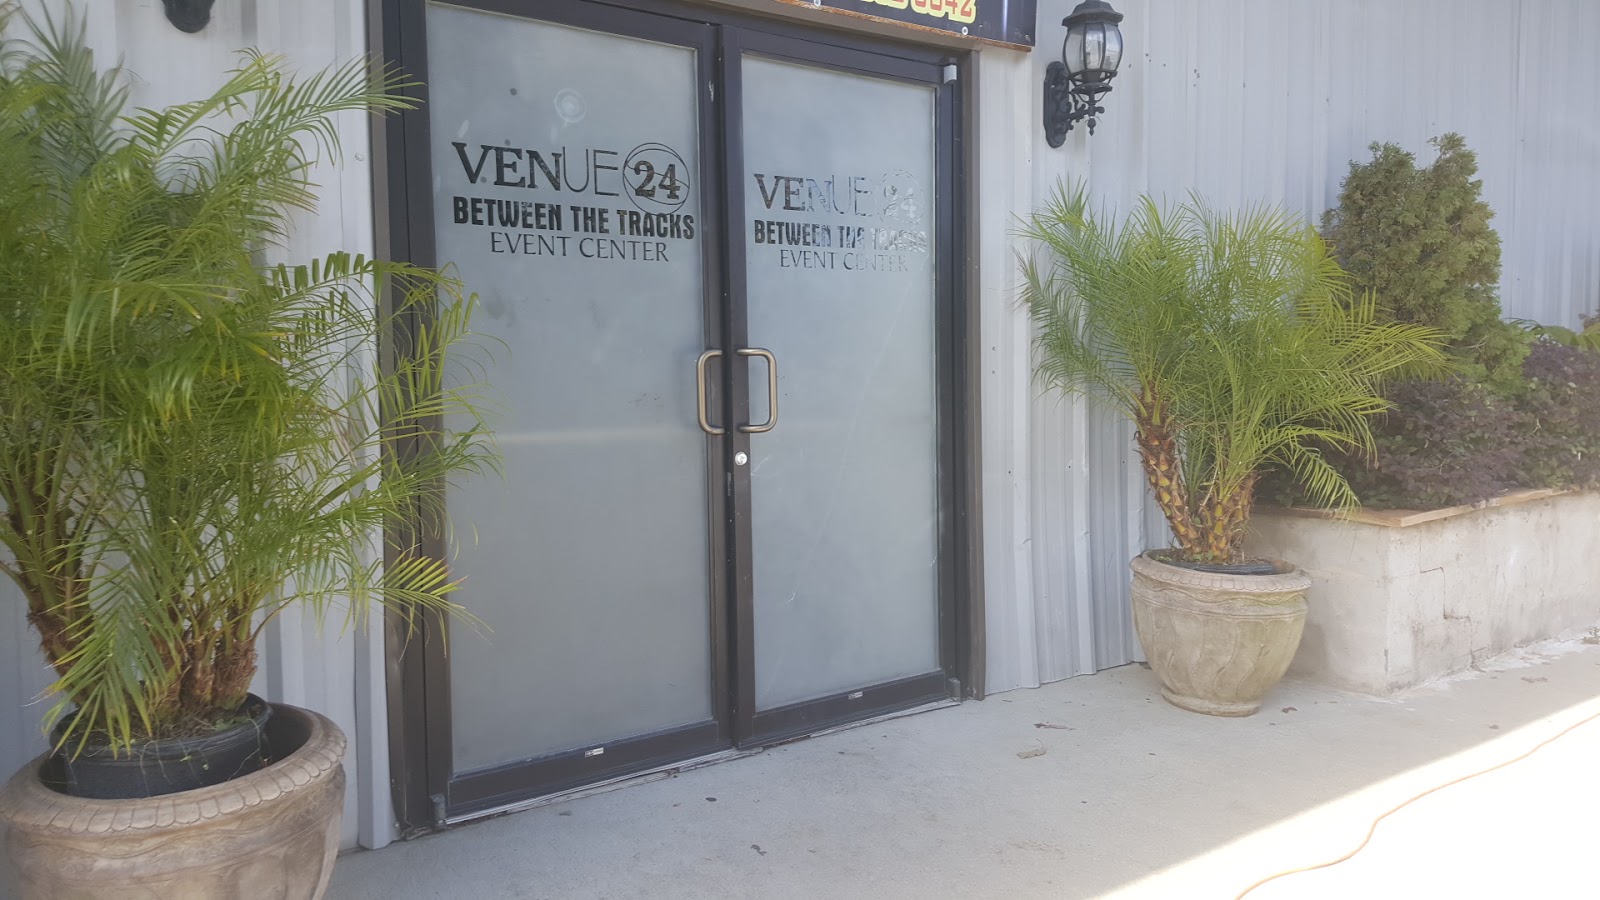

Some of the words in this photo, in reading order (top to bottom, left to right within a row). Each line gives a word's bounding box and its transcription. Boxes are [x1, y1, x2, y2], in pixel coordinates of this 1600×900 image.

[451, 141, 620, 197] VENUE
[633, 160, 681, 200] 24
[754, 173, 873, 217] VENUE
[453, 196, 562, 231] BETWEEN
[570, 206, 610, 234] THE
[616, 209, 695, 240] TRACKS
[754, 219, 832, 248] BETWEEN
[490, 232, 572, 257] EVENT
[579, 238, 669, 262] CENTER
[780, 250, 838, 269] EVENT
